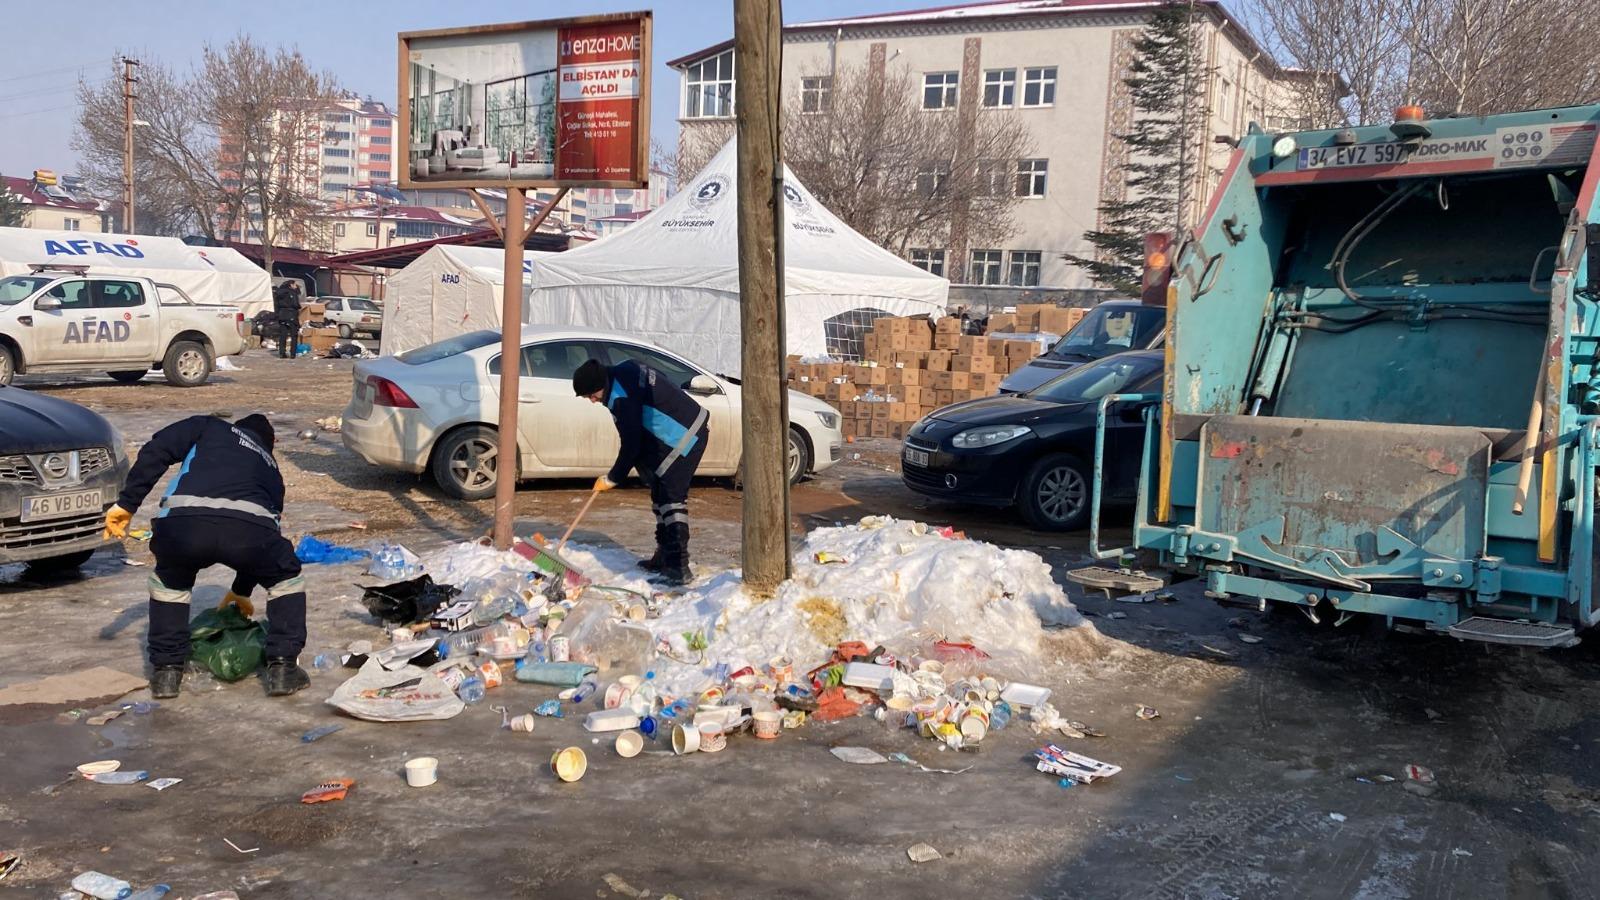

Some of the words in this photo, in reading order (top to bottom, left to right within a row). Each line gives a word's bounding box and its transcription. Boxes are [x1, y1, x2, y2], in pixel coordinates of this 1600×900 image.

[573, 37, 606, 55] enza
[622, 68, 638, 78] DA
[581, 83, 618, 96] AÇILDI
[1309, 148, 1328, 166] 34
[1335, 145, 1367, 165] EVZ
[1373, 143, 1404, 163] 597
[44, 240, 145, 258] AFAD
[441, 274, 460, 284] AFAD
[63, 320, 130, 344] AFAD
[31, 499, 50, 515] 46
[55, 496, 71, 512] VB
[75, 492, 100, 509] 090
